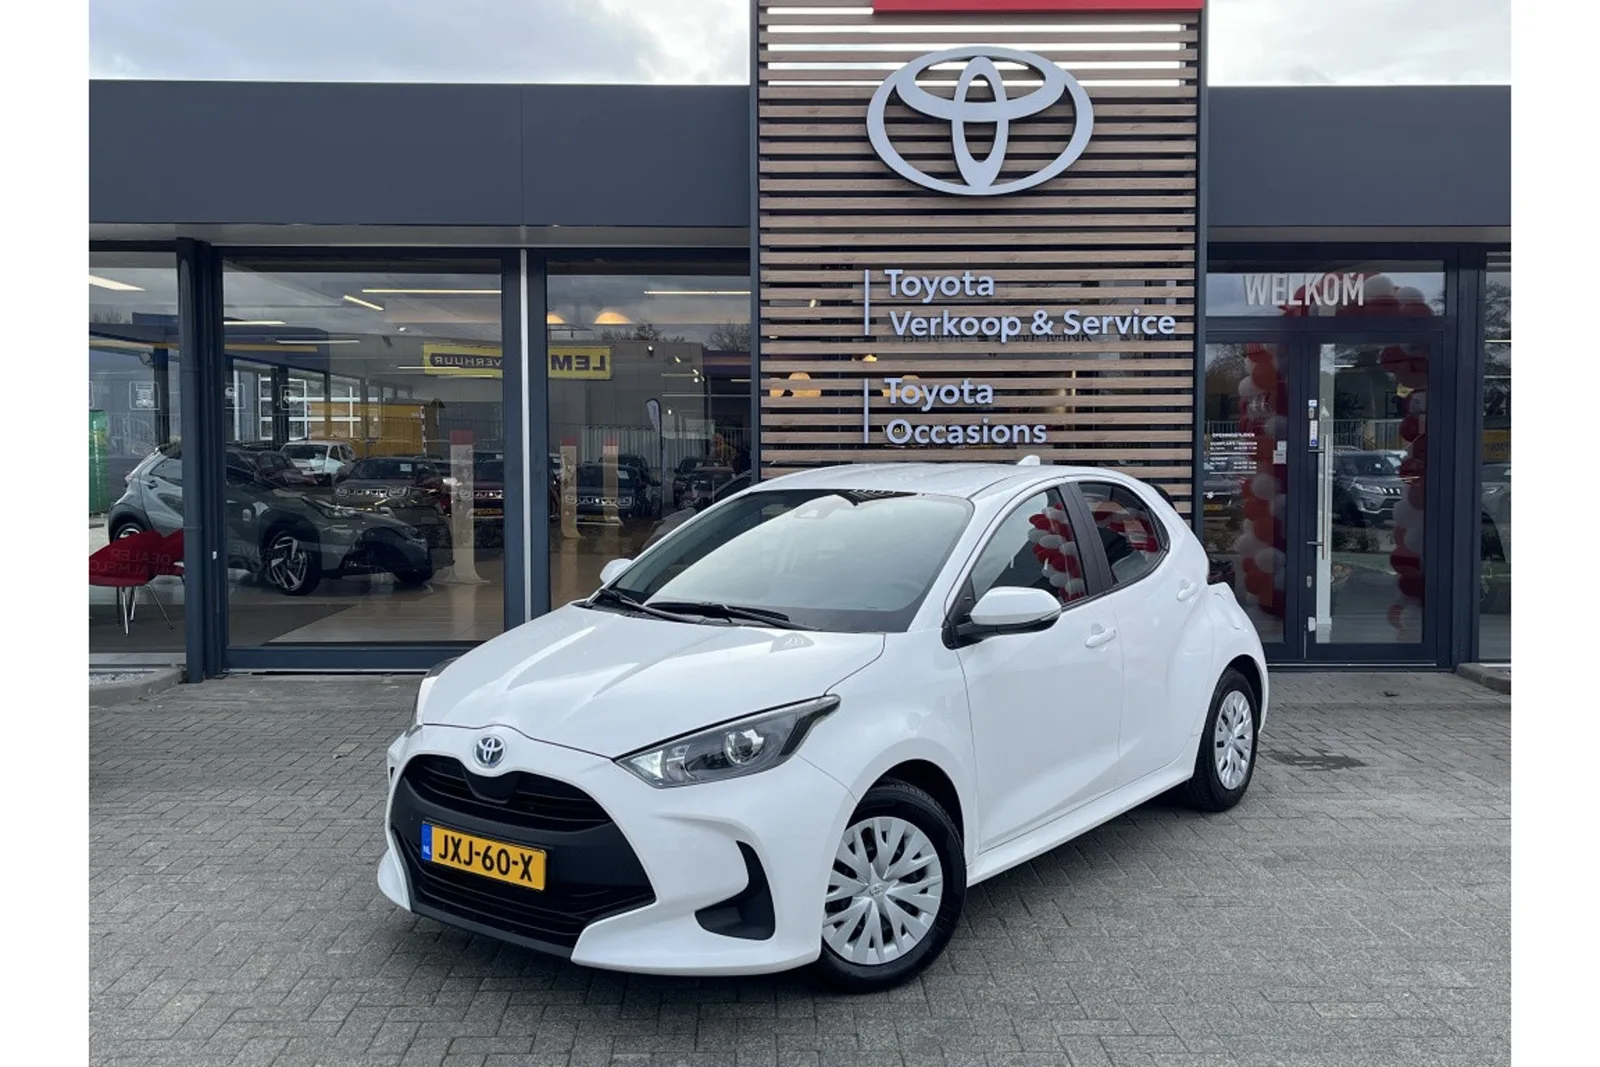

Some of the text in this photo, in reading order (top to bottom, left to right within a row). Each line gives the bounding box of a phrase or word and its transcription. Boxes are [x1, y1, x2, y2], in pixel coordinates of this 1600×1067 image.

[884, 269, 995, 304] Toyota
[1244, 273, 1365, 306] WELKOM
[889, 308, 1176, 343] Verkoop & Service
[884, 378, 993, 412] Toyota
[886, 418, 1047, 445] Occasions
[438, 834, 533, 882] JXJ-60-X
